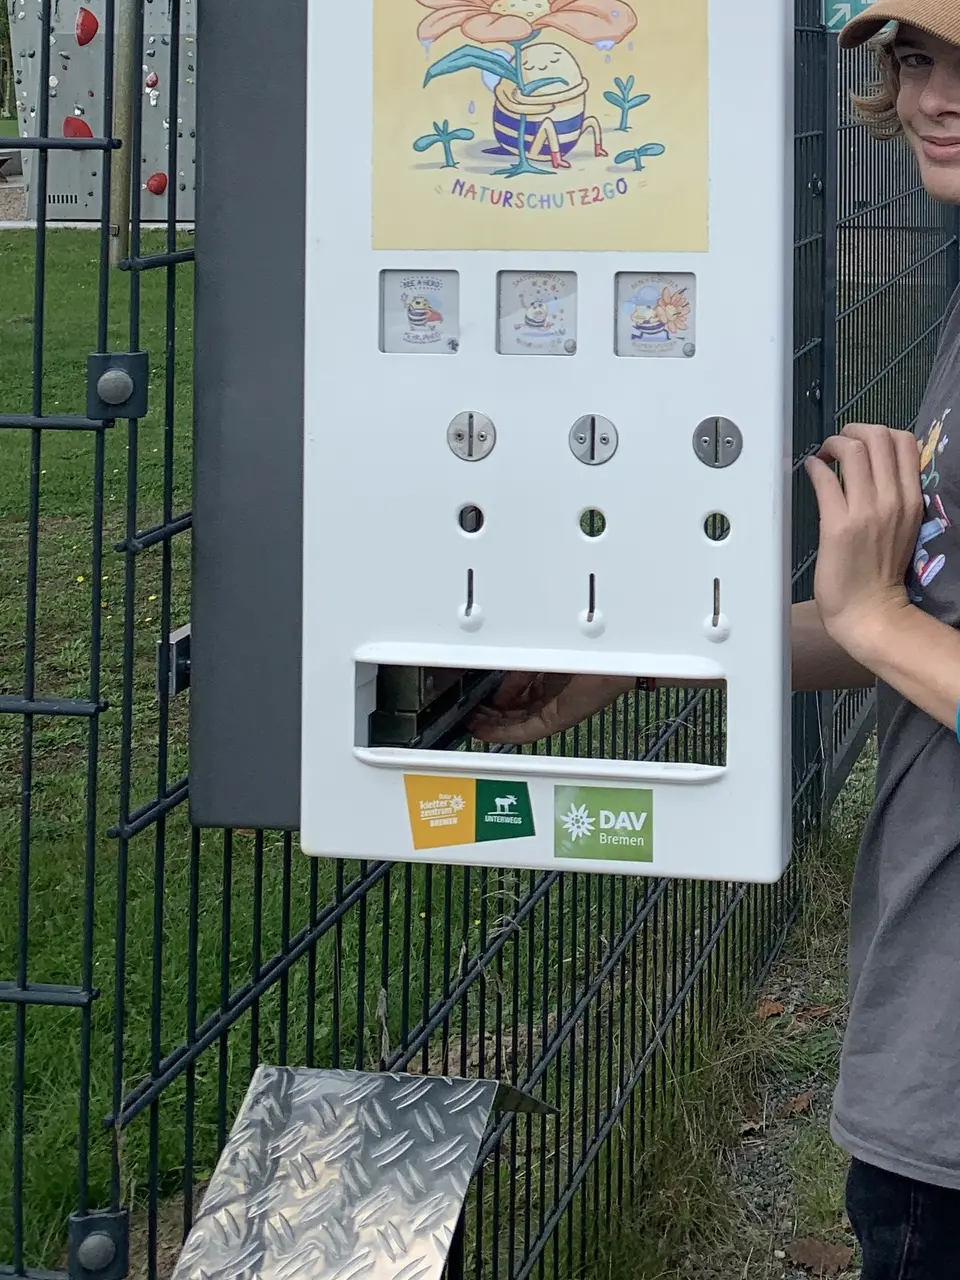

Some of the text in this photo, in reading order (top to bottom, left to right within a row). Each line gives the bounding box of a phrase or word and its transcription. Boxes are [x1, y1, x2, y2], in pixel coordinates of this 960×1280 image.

[451, 177, 629, 210] NATURSCHUTZ2GO
[419, 799, 449, 810] kletter
[484, 815, 523, 825] UNTERWEGS
[599, 810, 648, 831] DAV
[599, 833, 644, 846] Bremen
